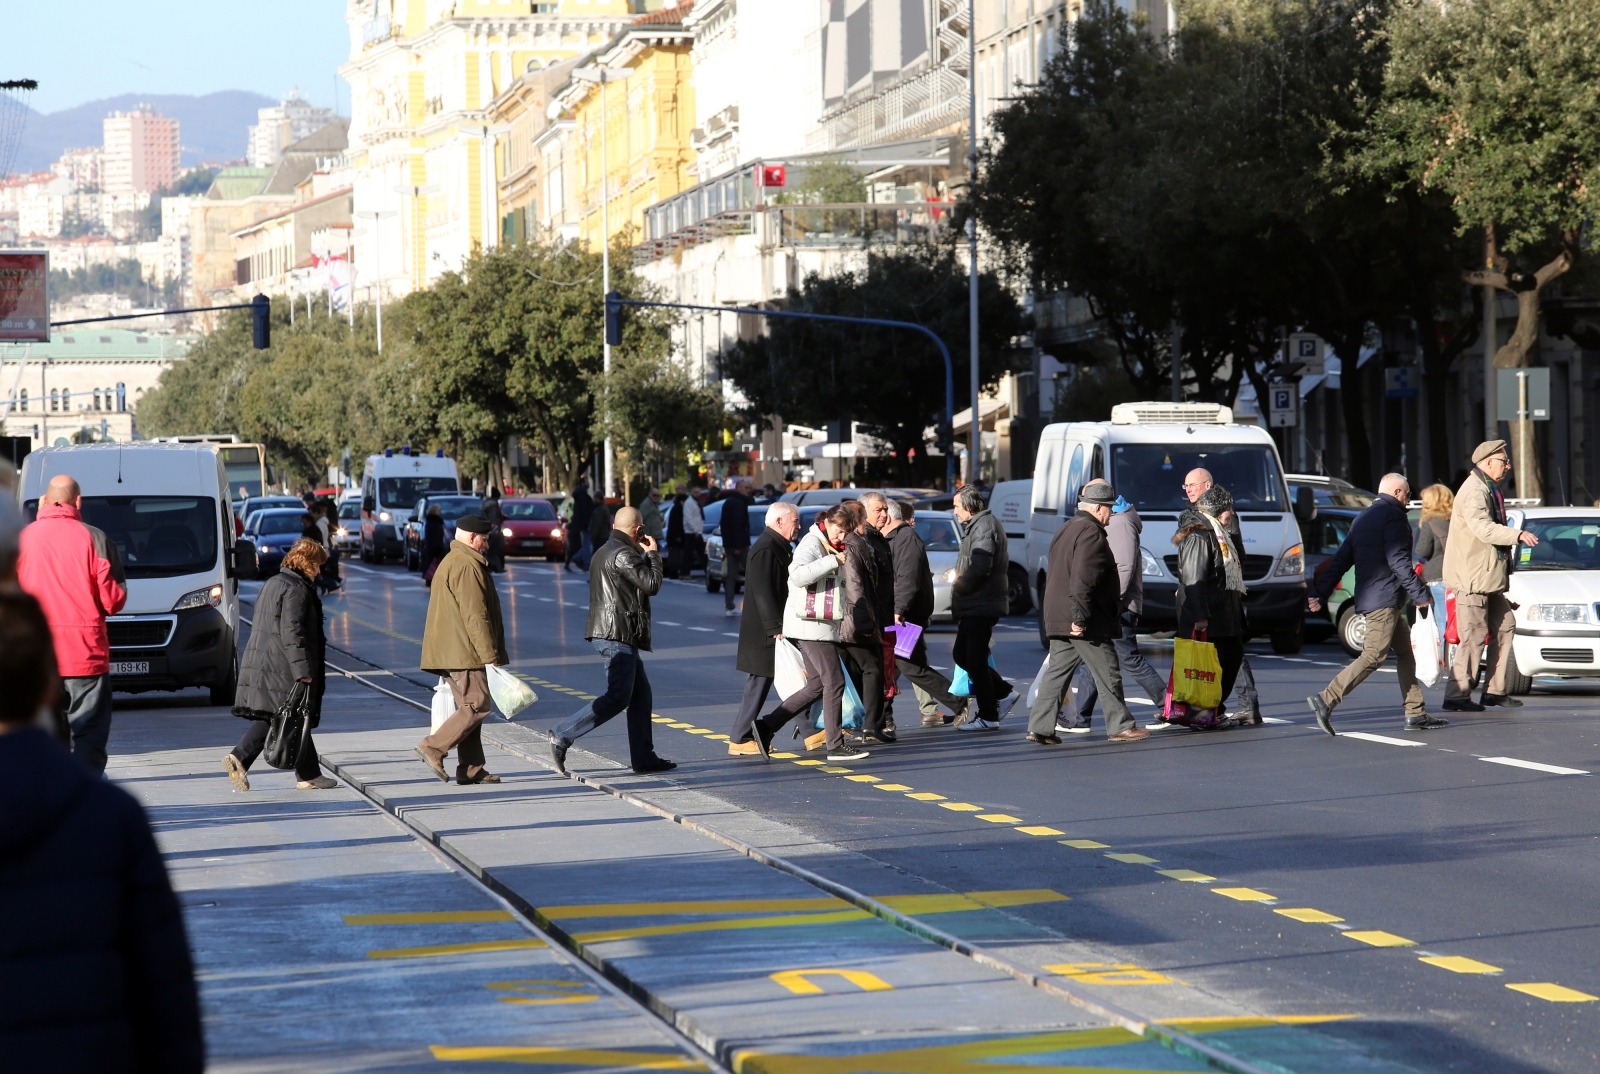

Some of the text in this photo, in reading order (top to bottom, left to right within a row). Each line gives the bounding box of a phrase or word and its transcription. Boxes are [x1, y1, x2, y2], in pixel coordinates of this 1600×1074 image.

[0, 320, 12, 328] 80
[1302, 342, 1313, 355] P
[1278, 393, 1287, 406] P
[116, 662, 148, 672] 169-KR
